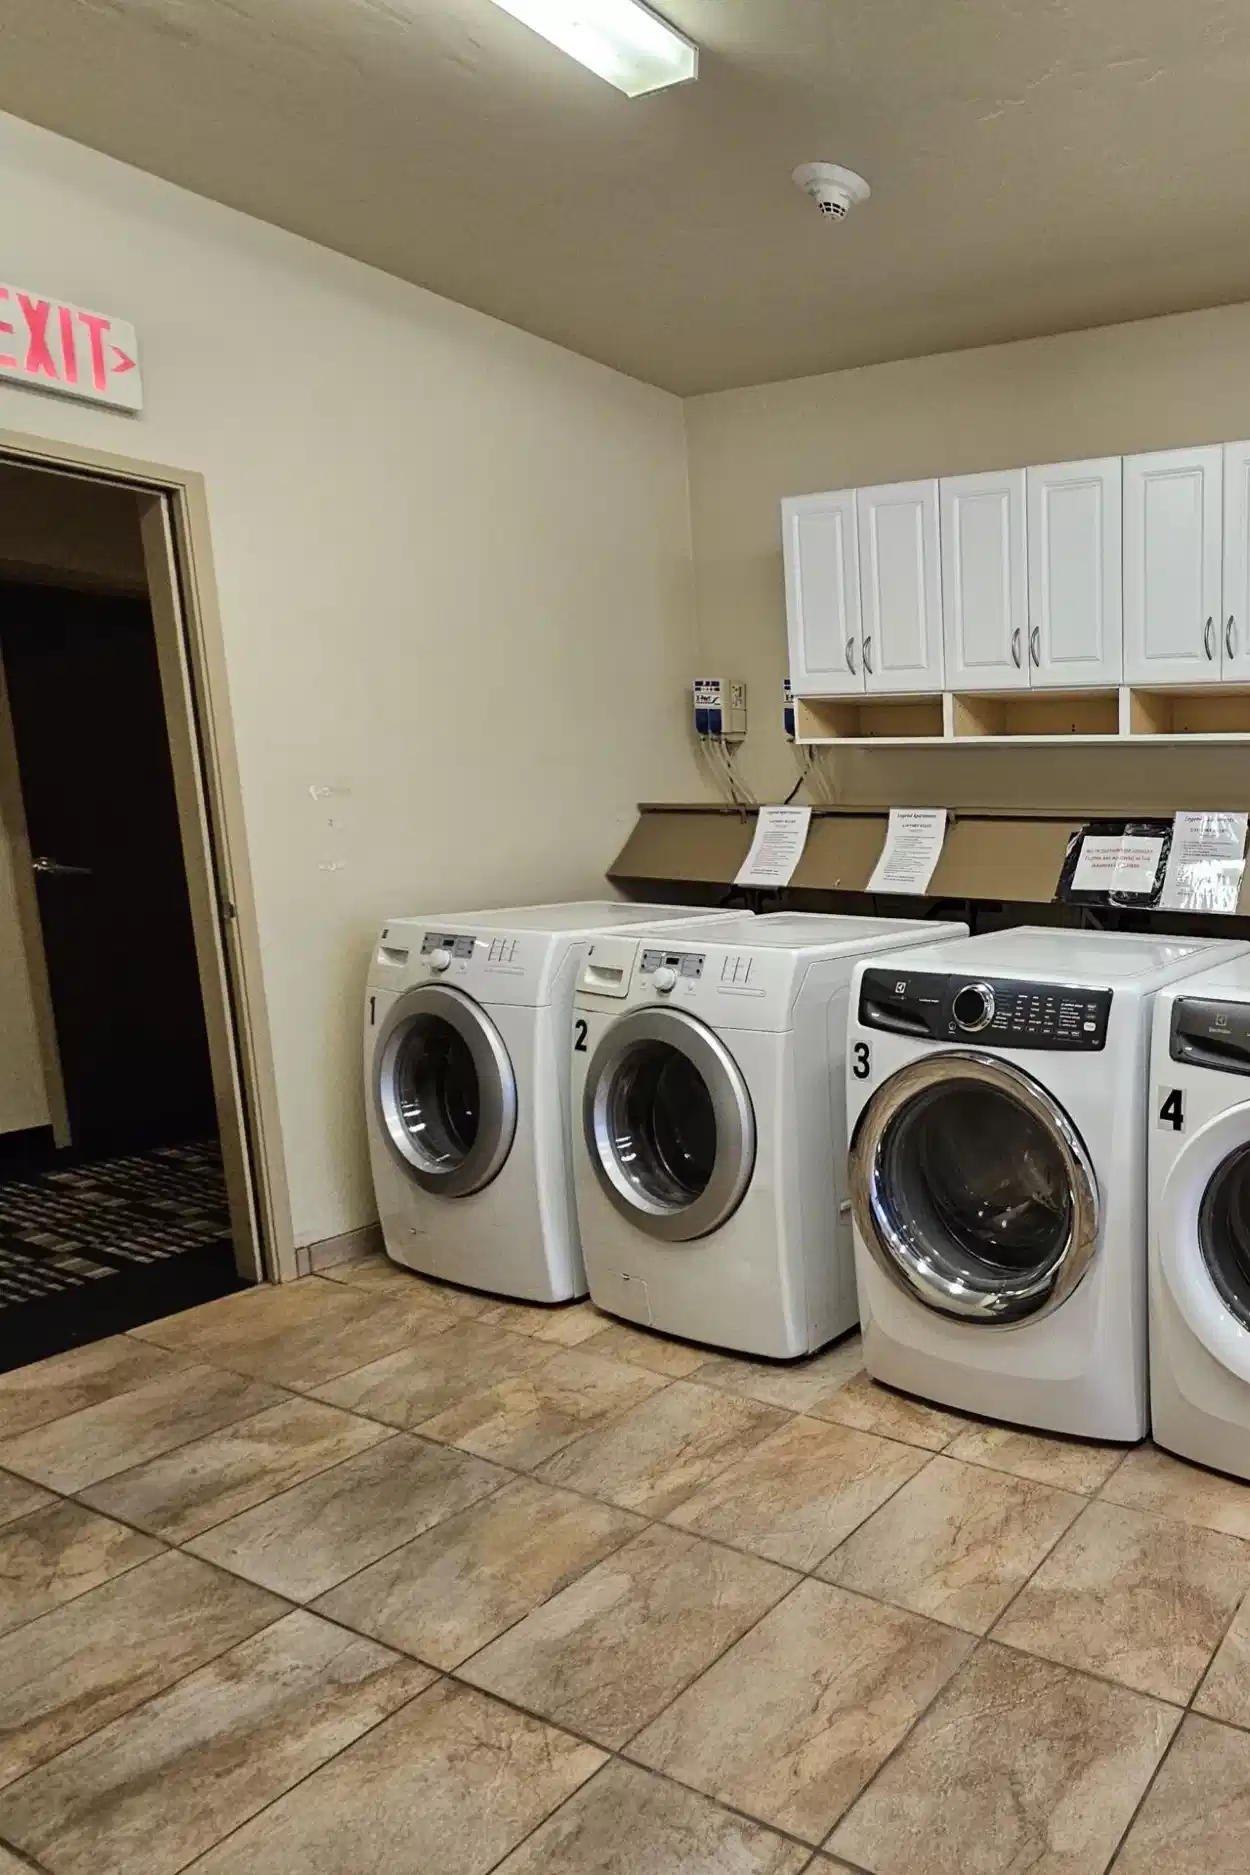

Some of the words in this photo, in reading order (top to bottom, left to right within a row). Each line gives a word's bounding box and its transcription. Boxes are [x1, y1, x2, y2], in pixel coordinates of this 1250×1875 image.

[370, 996, 376, 1026] 1
[575, 1019, 588, 1053] 2
[853, 1042, 870, 1079] 3
[1159, 1089, 1184, 1132] 4
